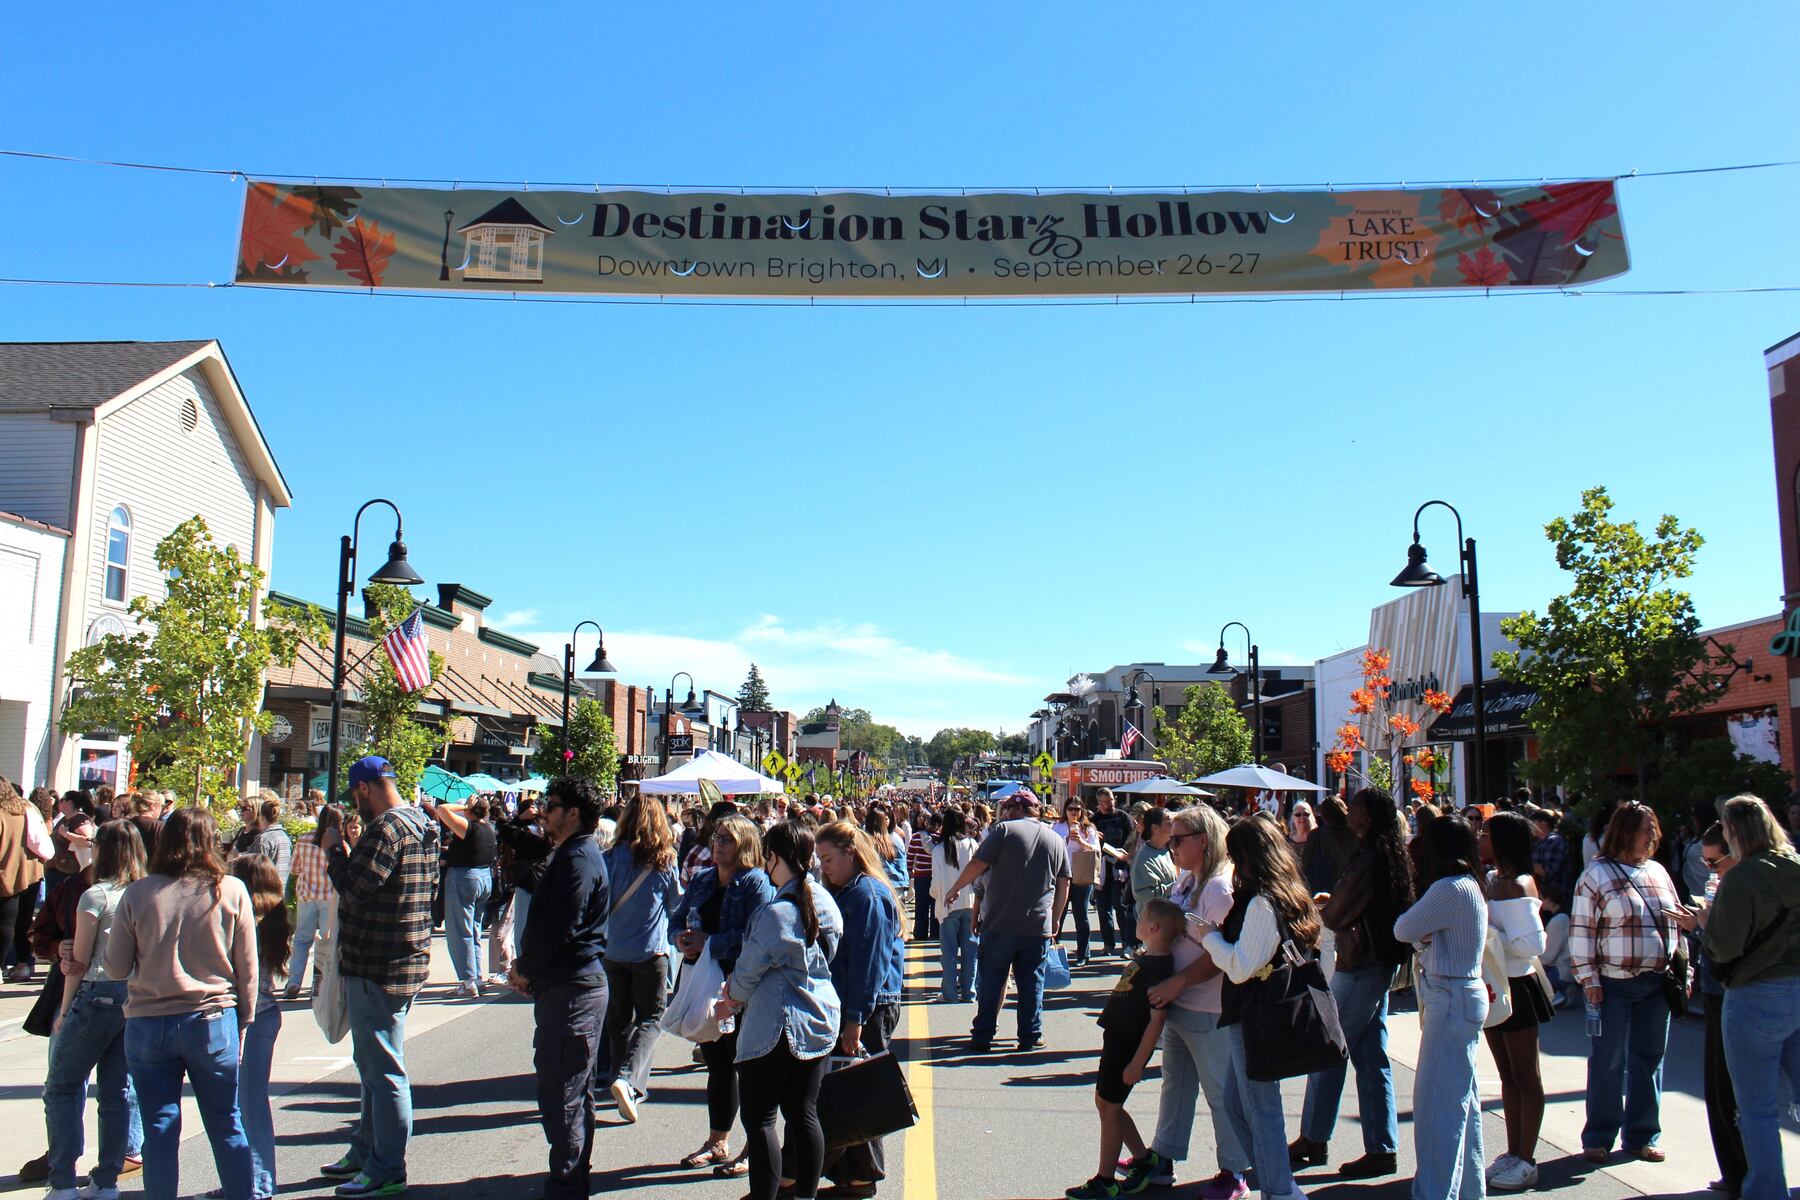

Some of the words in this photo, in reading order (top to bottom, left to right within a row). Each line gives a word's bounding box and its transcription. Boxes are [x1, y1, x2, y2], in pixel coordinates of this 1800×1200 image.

[587, 202, 906, 241] Destination
[919, 205, 1083, 259] Starz
[1081, 200, 1269, 238] Hollow
[1346, 217, 1416, 236] LAKE
[1340, 240, 1424, 260] TRUST
[598, 254, 755, 277] Downtown
[767, 257, 905, 283] Brighton,
[917, 257, 948, 279] MI
[994, 254, 1167, 283] September
[1178, 252, 1260, 275] 26-27
[316, 722, 345, 740] GENL
